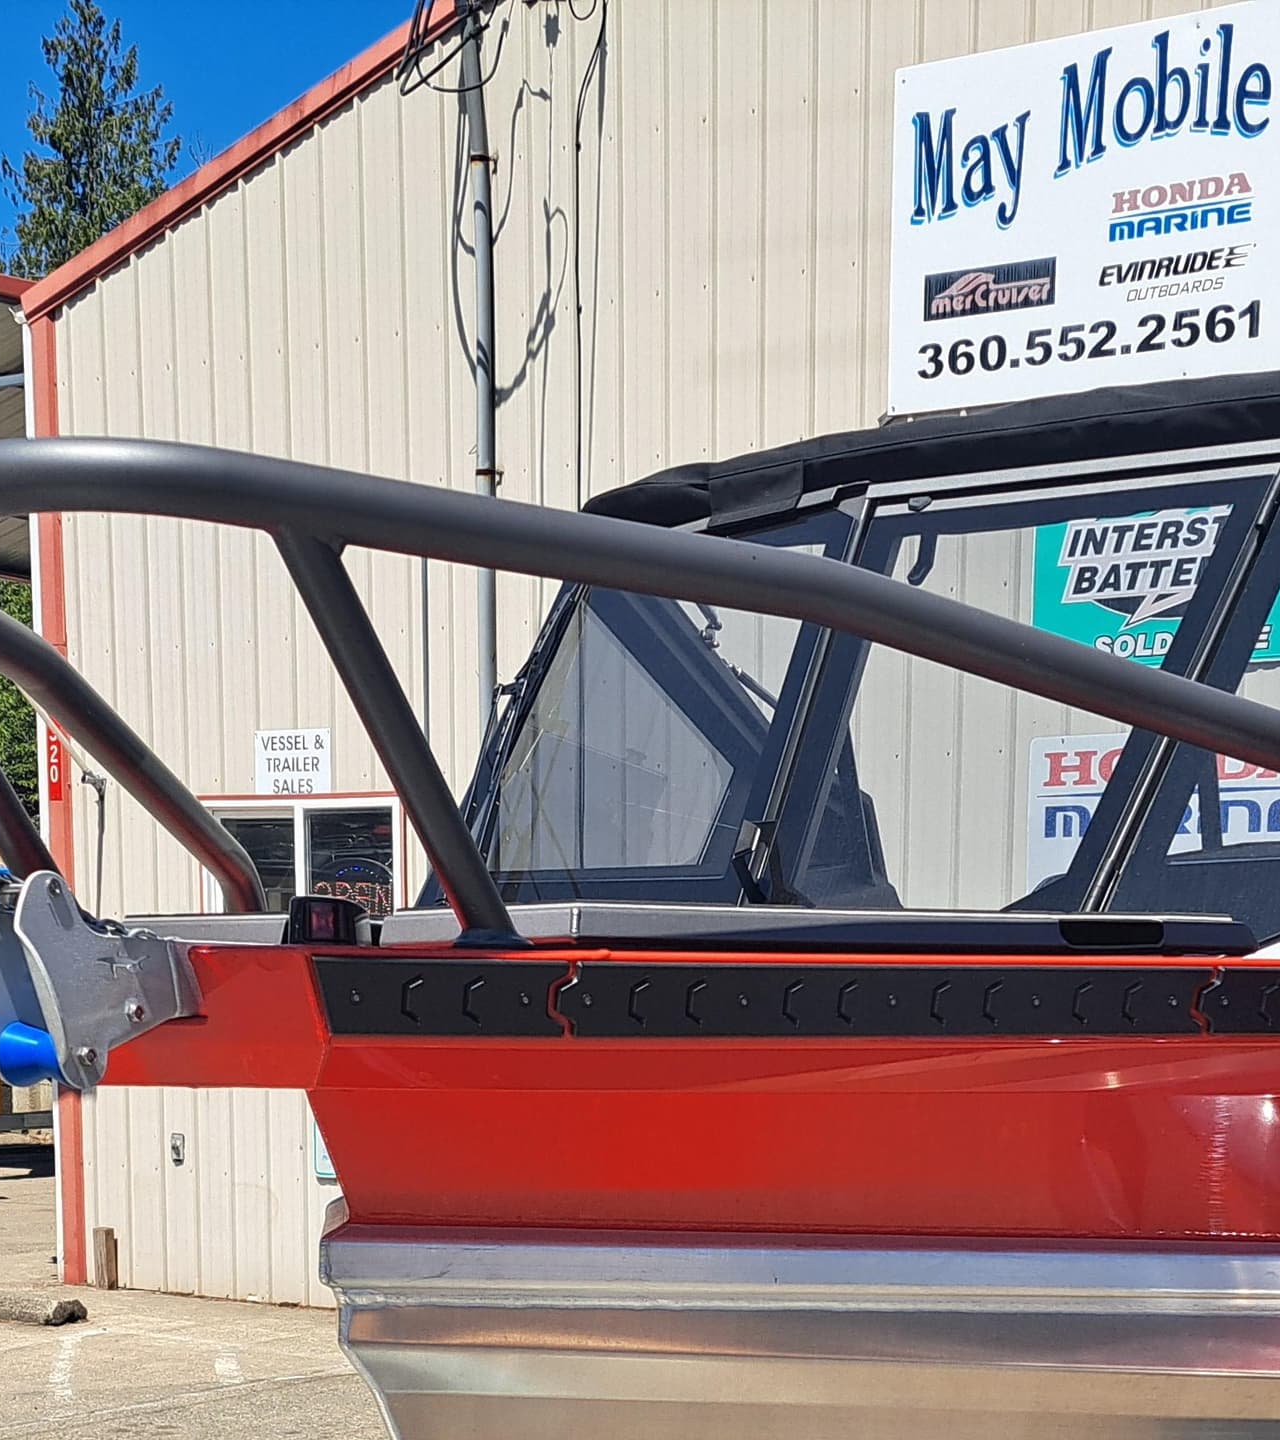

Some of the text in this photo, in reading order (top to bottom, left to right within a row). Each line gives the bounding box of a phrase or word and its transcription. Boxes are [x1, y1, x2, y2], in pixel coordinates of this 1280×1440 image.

[910, 107, 1030, 230] May
[1054, 22, 1272, 180] Mobile
[1112, 172, 1252, 213] HONDA
[1108, 202, 1253, 243] MARINE
[1098, 247, 1225, 287] EVINRUDE
[1126, 276, 1225, 303] OUTBOARDS
[917, 299, 1262, 380] 360.552.2561
[261, 733, 325, 752] VESSEL &
[266, 756, 320, 773] TRAILER
[272, 778, 314, 795] SALES
